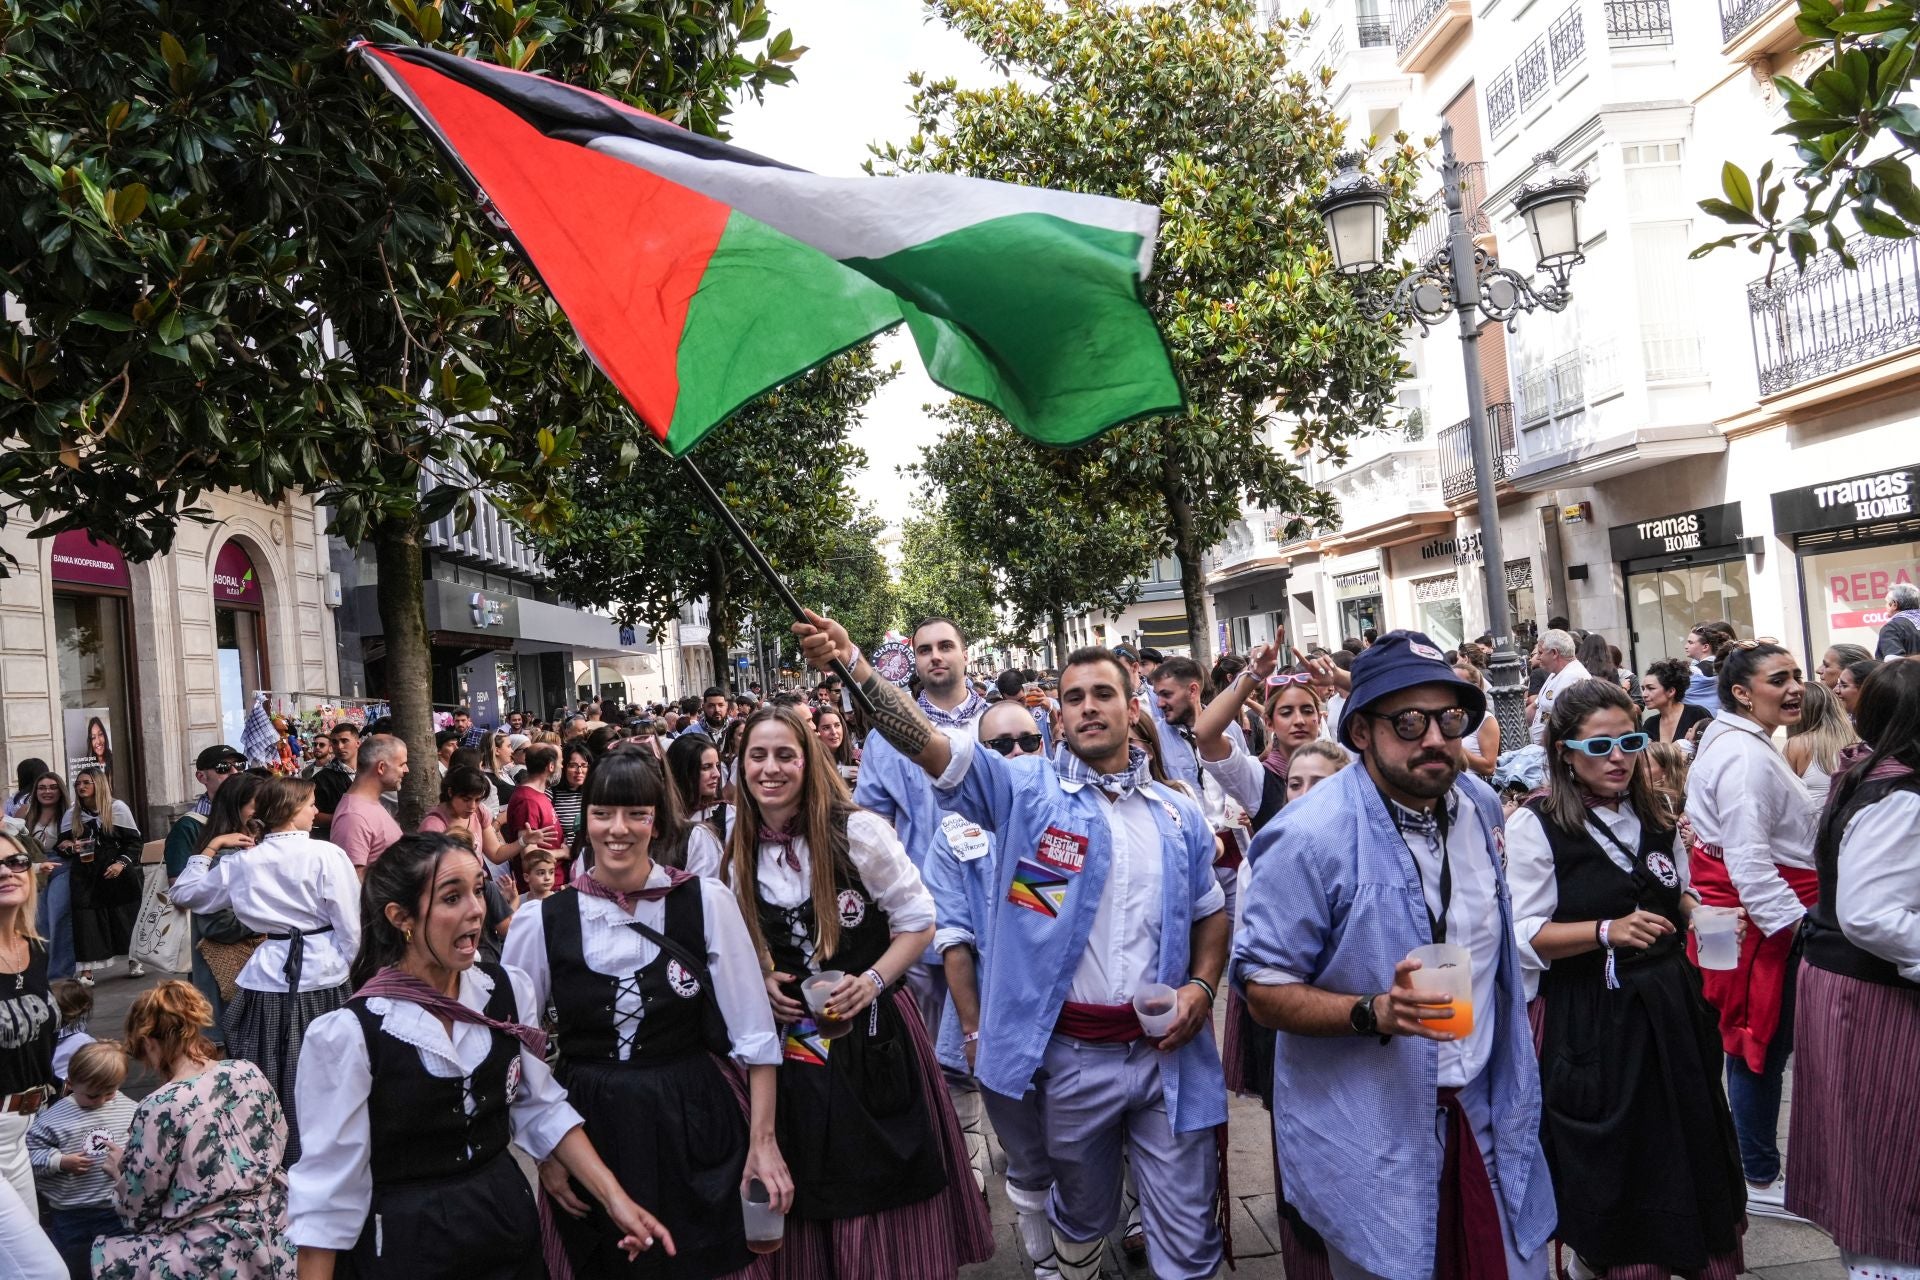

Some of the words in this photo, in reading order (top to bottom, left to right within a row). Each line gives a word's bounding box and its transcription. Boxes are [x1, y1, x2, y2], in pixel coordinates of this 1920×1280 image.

[1855, 495, 1911, 520] HOME
[1664, 533, 1701, 552] HOME
[53, 554, 74, 565] BANKA
[74, 557, 115, 571] KOOPERATIBOA
[213, 574, 239, 587] ABORAL
[1830, 567, 1920, 603] REBA
[873, 643, 916, 665] CHARANGA
[1041, 832, 1080, 854] PALESTINA
[1047, 846, 1085, 868] ASKATU!
